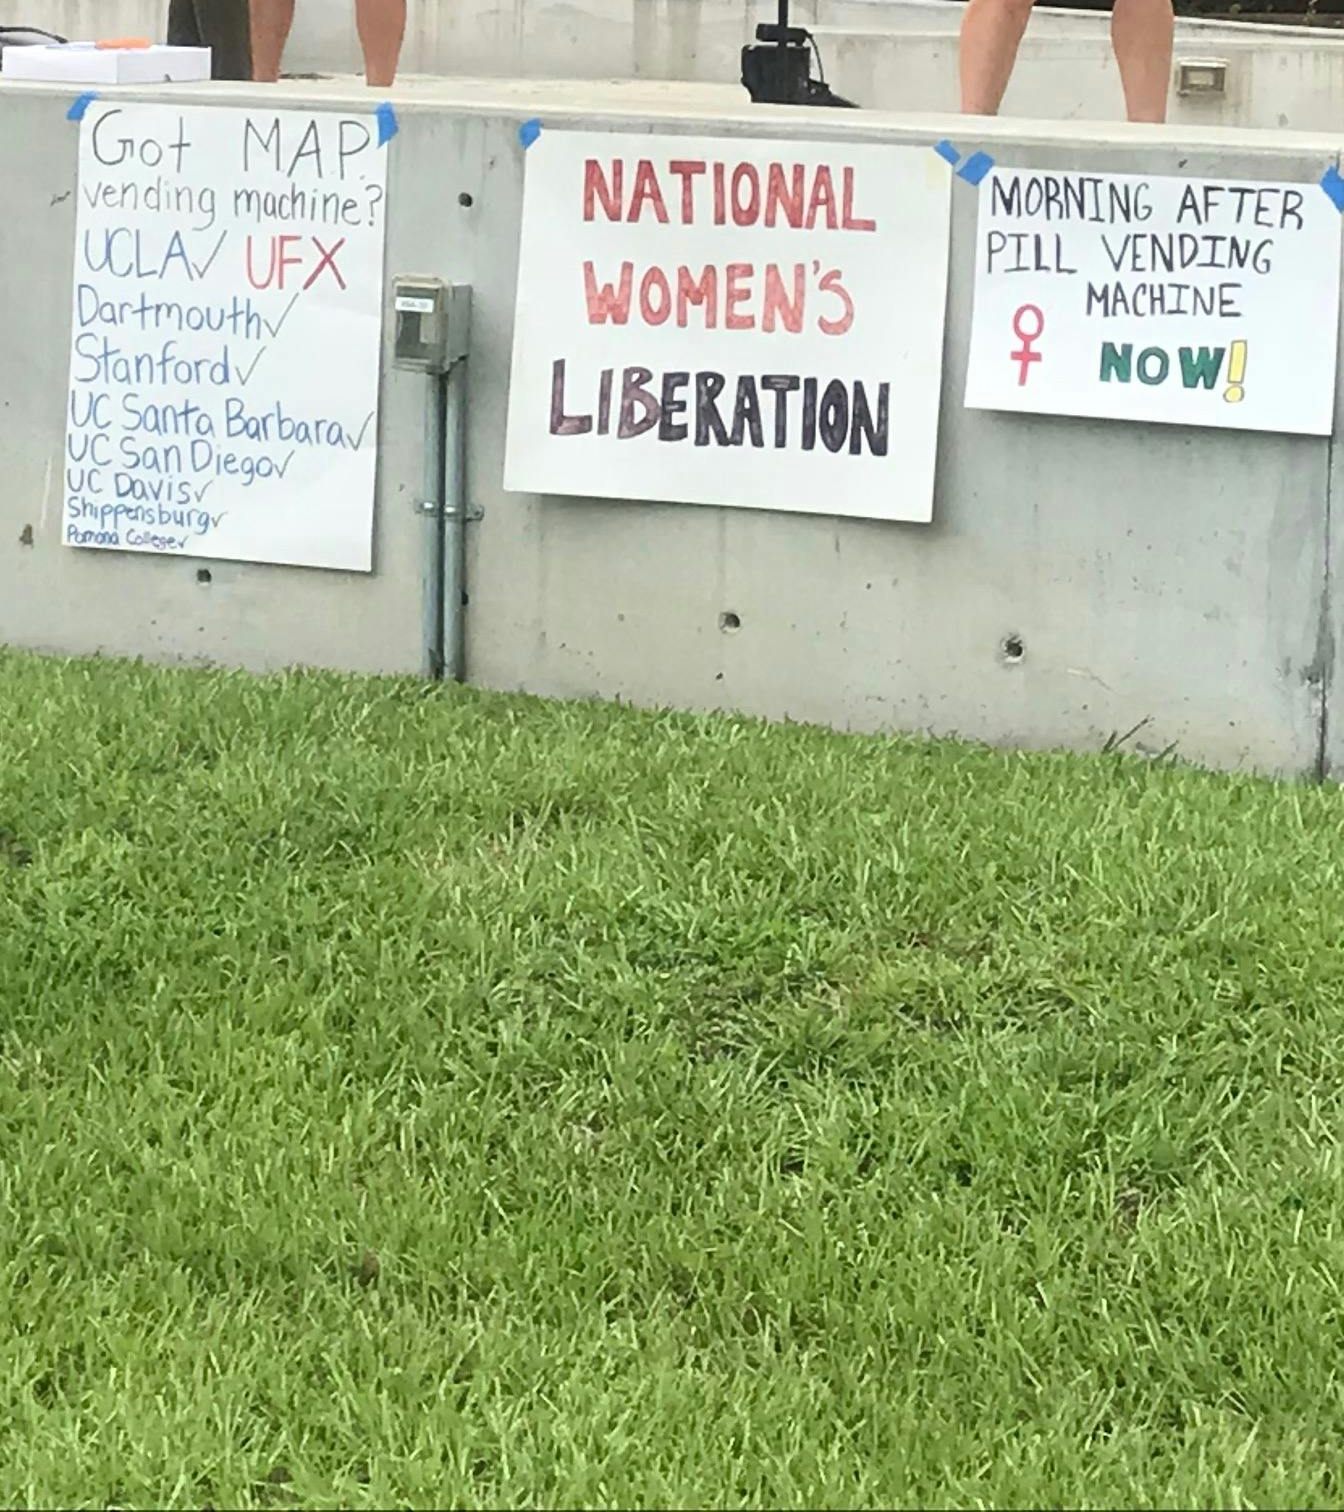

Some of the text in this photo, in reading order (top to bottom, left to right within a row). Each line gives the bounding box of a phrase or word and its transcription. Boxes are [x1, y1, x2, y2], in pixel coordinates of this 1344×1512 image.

[93, 109, 191, 173] Got
[83, 178, 384, 232] vending machine?
[583, 158, 877, 232] NATIONAL
[991, 176, 1304, 230] MORNING AFTER
[987, 231, 1272, 274] PILL VENDING
[78, 284, 261, 339] Dartmouth
[583, 259, 855, 336] WOMEN'S
[1086, 283, 1243, 318] MACHINE
[74, 332, 229, 385] Stanford
[1099, 340, 1248, 403] NOW!
[71, 390, 346, 448] UC Santa Barbara
[549, 358, 890, 457] LIBERATION
[67, 433, 274, 486] UC San Diego
[67, 468, 191, 504] UC Davis
[67, 496, 211, 534] Shippensburg
[67, 525, 120, 545] Pomona
